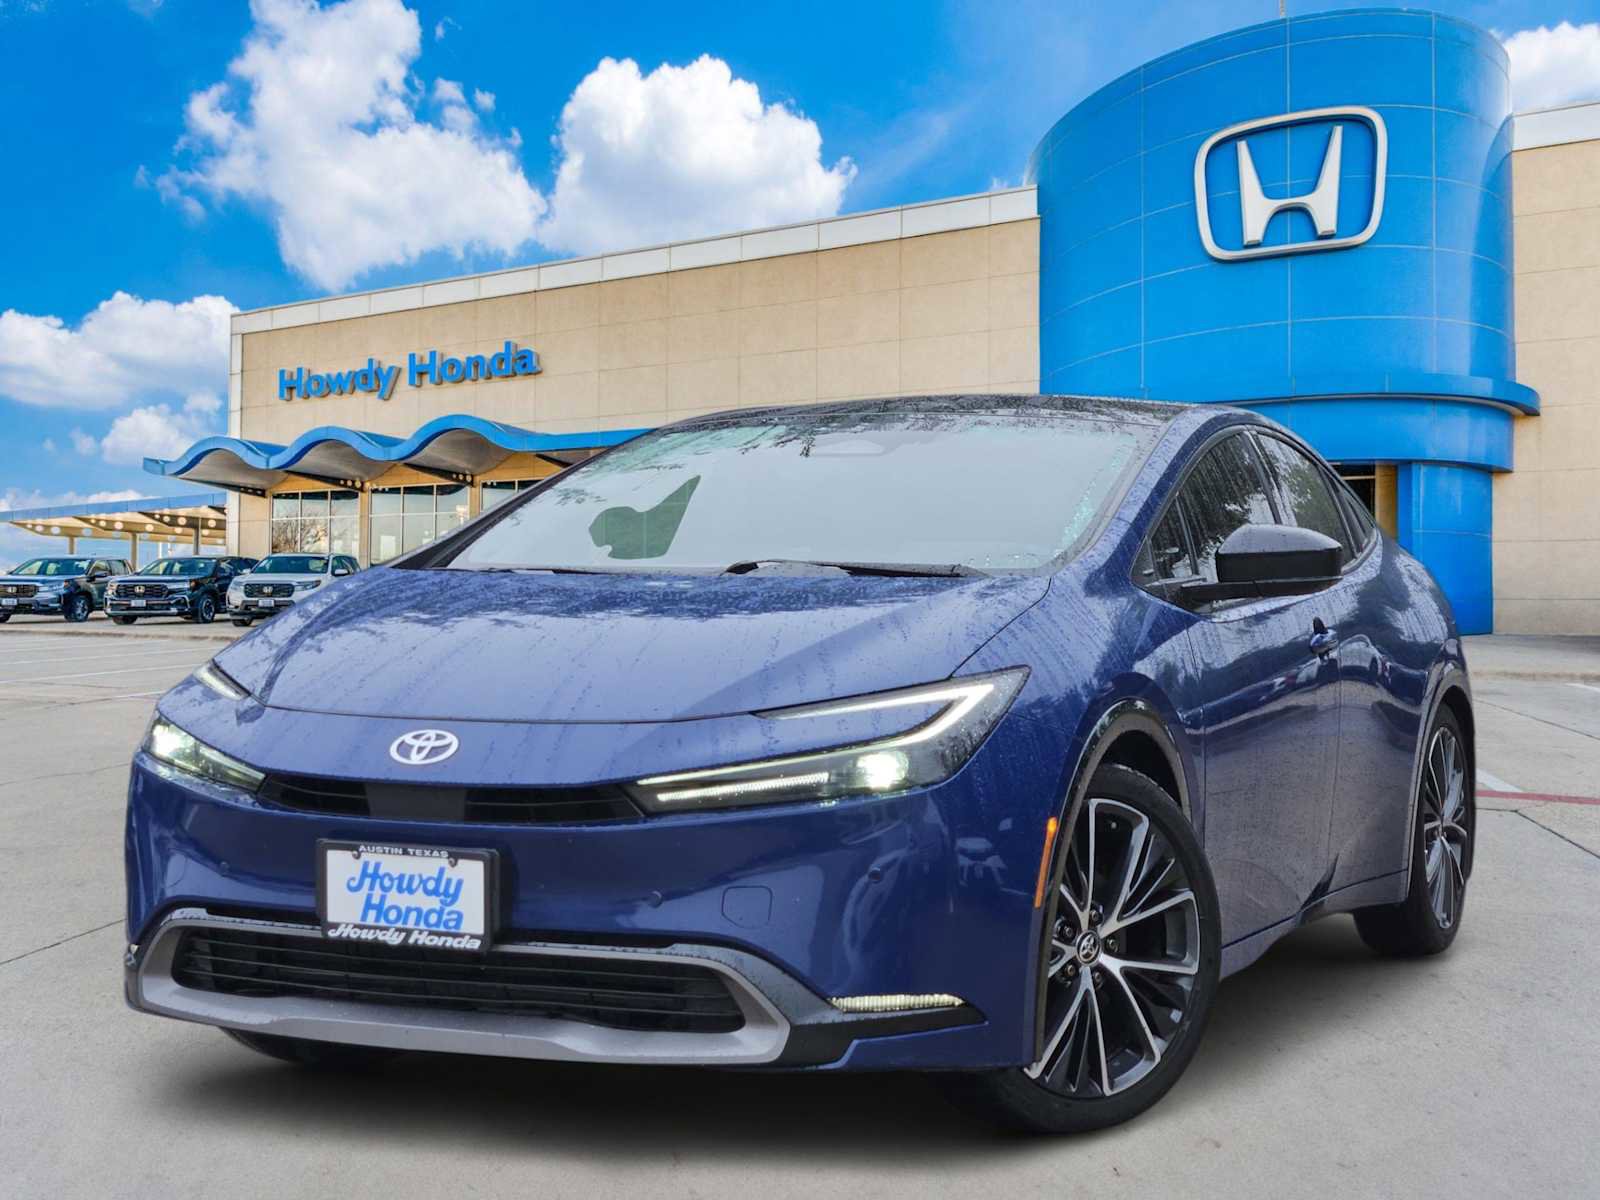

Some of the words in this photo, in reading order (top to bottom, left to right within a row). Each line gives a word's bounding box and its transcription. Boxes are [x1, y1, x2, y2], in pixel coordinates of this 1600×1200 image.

[278, 358, 400, 400] Howdy
[407, 341, 541, 388] Honda
[359, 845, 403, 855] AUSTIN
[408, 848, 449, 858] TEXAS
[346, 860, 464, 907] Howdy
[360, 893, 464, 931] Honda
[328, 924, 406, 945] Howdy
[408, 930, 481, 949] Honda
